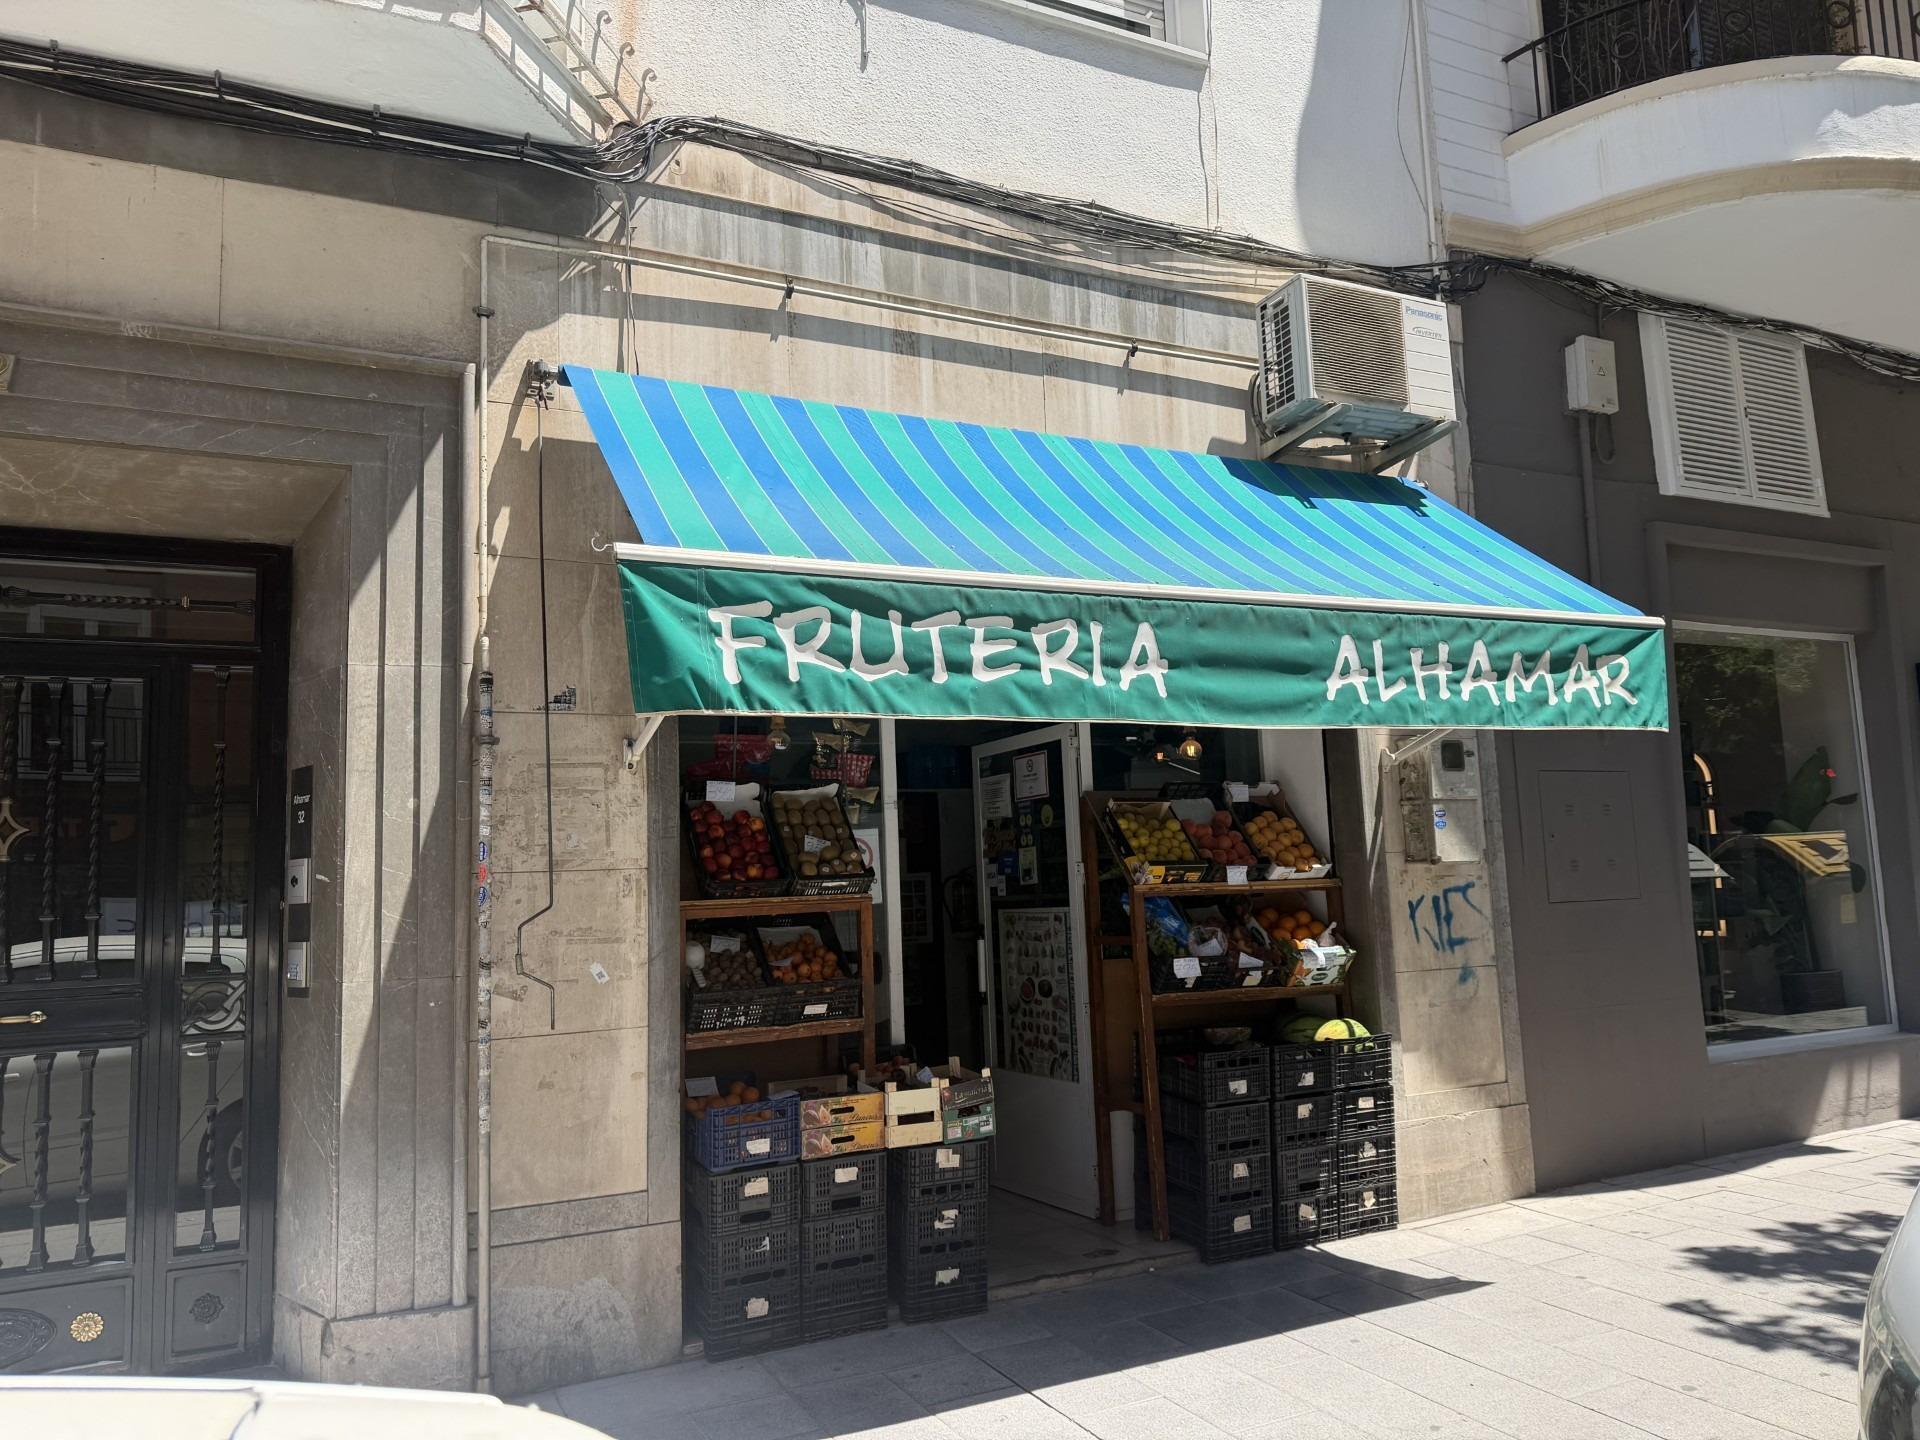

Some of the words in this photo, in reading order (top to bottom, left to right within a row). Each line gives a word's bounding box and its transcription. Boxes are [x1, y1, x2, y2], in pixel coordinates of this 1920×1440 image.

[1405, 305, 1443, 321] Panasonic
[707, 599, 1168, 698] FRUTERIA
[1325, 634, 1639, 708] ALHAMAR
[297, 810, 305, 824] 32
